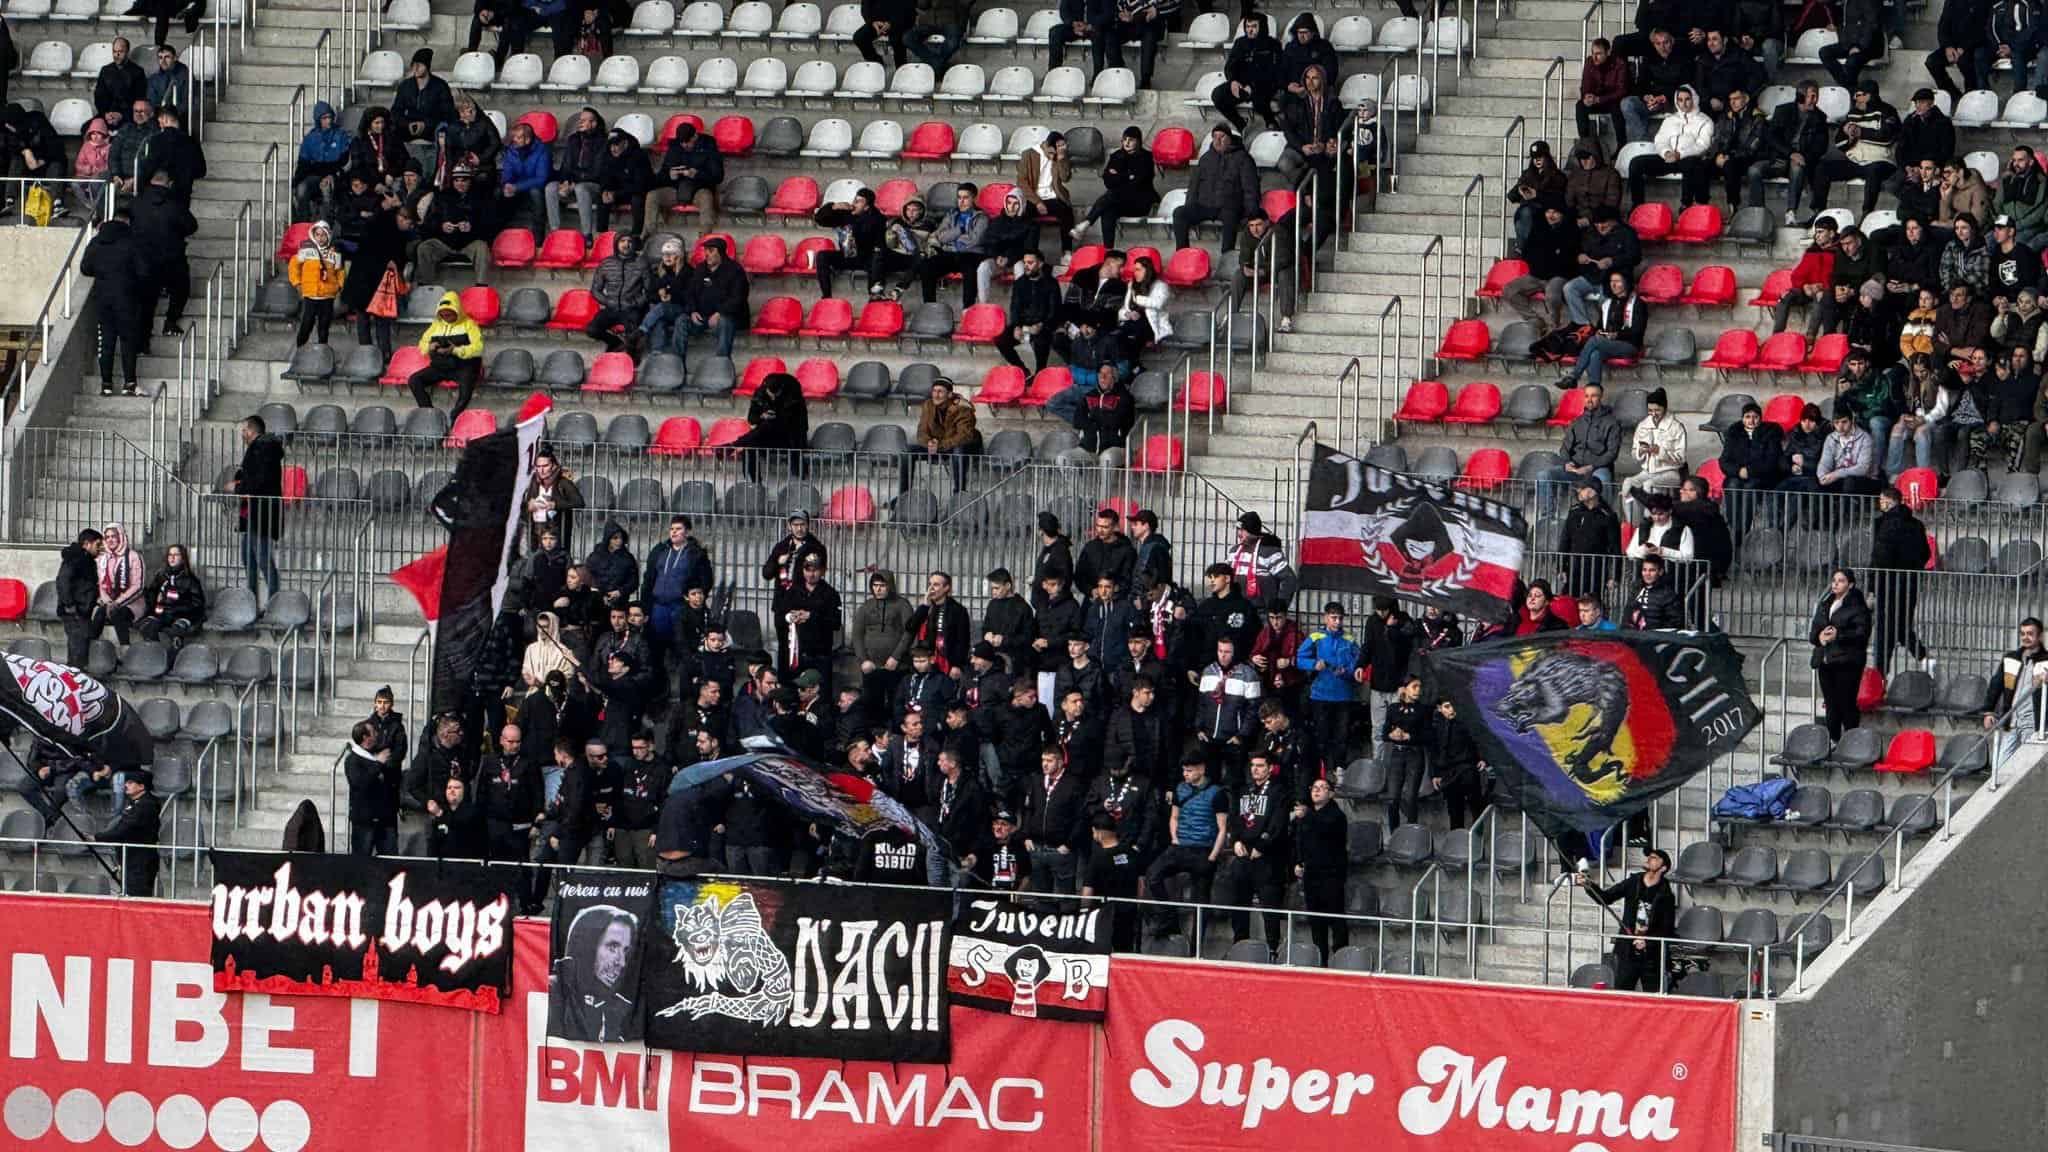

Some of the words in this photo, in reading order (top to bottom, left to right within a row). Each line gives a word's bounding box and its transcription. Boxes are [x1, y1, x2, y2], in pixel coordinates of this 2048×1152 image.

[1701, 706, 1744, 746] 2017
[603, 885, 621, 898] cu
[625, 881, 649, 897] noi
[874, 855, 915, 869] SIBIU
[212, 861, 366, 949] urban
[379, 872, 509, 973] boys
[970, 900, 1101, 944] Juvenil
[960, 944, 993, 988] S
[1062, 958, 1092, 1001] B
[537, 1045, 662, 1112] BMI
[688, 1059, 1044, 1132] BRAMAC
[1129, 1018, 1374, 1129] Super
[1398, 1045, 1679, 1142] Mama
